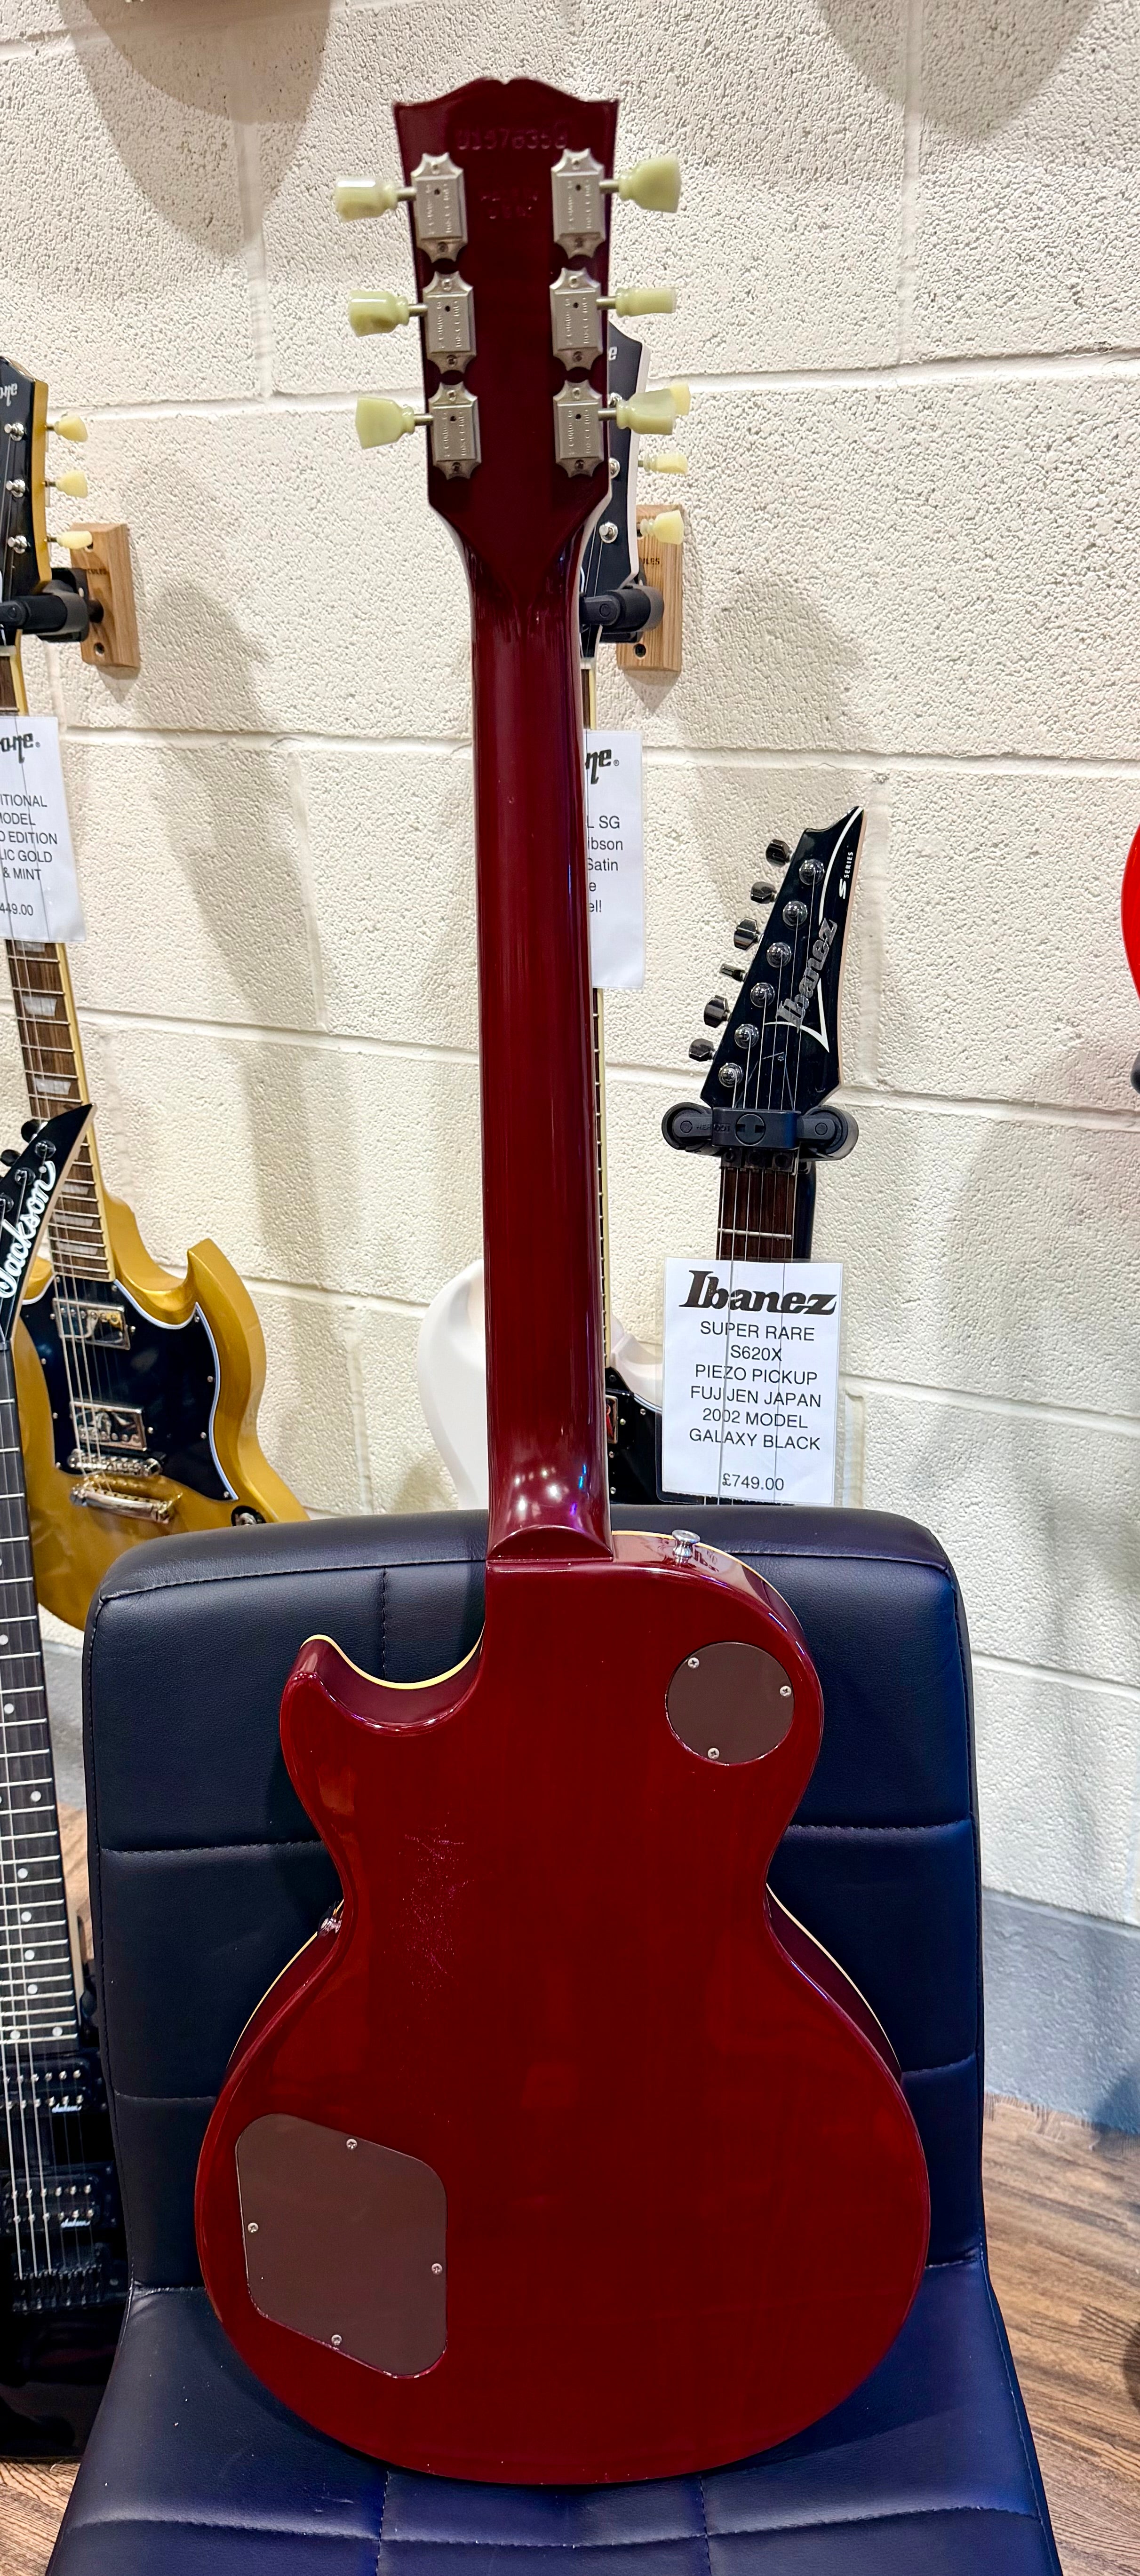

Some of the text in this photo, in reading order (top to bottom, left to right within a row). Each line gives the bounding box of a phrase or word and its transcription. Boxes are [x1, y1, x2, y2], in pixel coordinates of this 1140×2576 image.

[0, 794, 48, 807] ITIONAL
[599, 815, 620, 829] SG
[8, 831, 57, 845] EDITION
[588, 837, 623, 851] ibson
[18, 850, 52, 863] GOLD
[588, 857, 618, 872] Satin
[844, 851, 853, 879] SERIES
[13, 867, 41, 880] MINT
[775, 918, 837, 1034] Ibanez
[679, 1270, 837, 1316] Ibanez
[700, 1321, 815, 1341] SUPER RARE
[730, 1344, 782, 1361] S620X
[695, 1364, 818, 1385] PIEZO PICKUP
[764, 1391, 821, 1407] JAPAN
[702, 1408, 808, 1428] 2002 MODEL
[689, 1428, 821, 1450] GALAXY BLACK
[722, 1473, 784, 1491] £749.00
